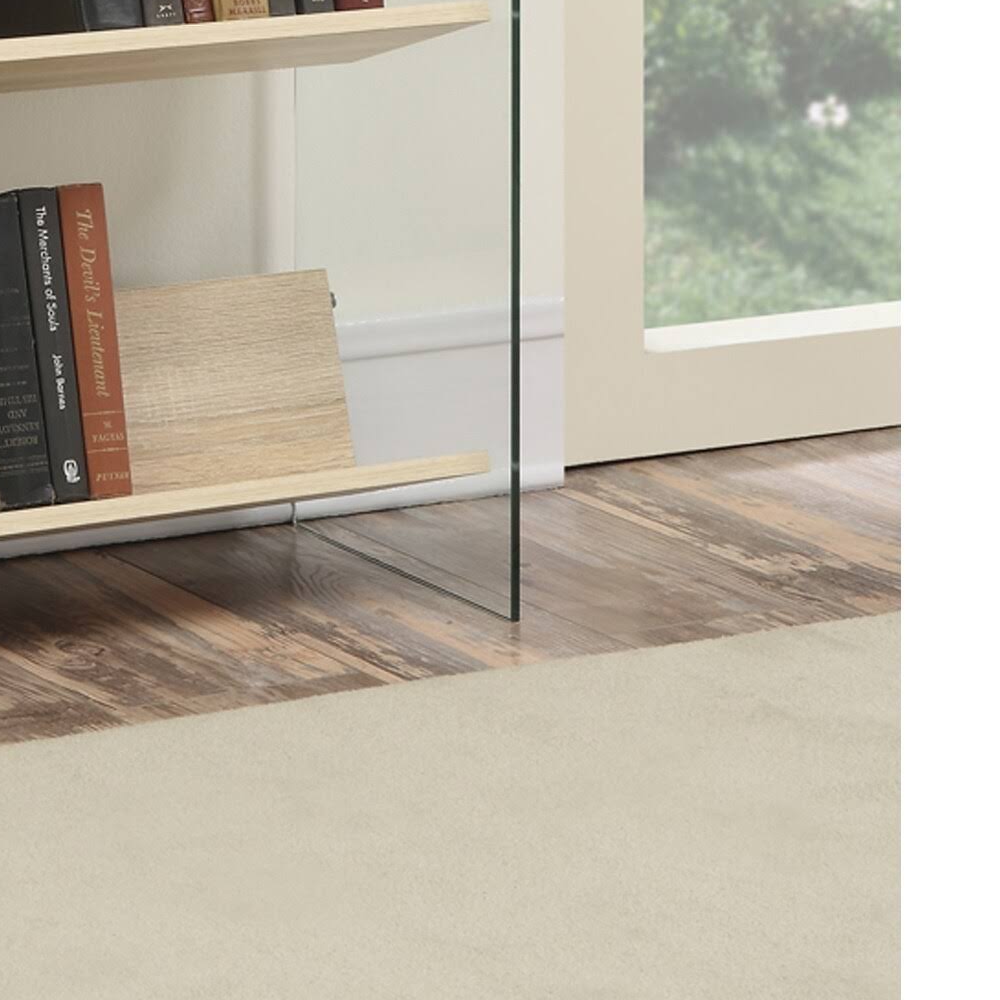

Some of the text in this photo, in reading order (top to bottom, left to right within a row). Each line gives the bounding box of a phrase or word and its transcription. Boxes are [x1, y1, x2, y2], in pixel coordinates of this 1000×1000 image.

[36, 206, 60, 332] The Merchants of Souls
[76, 208, 111, 398] The Devil's Lieutenant
[52, 354, 66, 410] John Barnes
